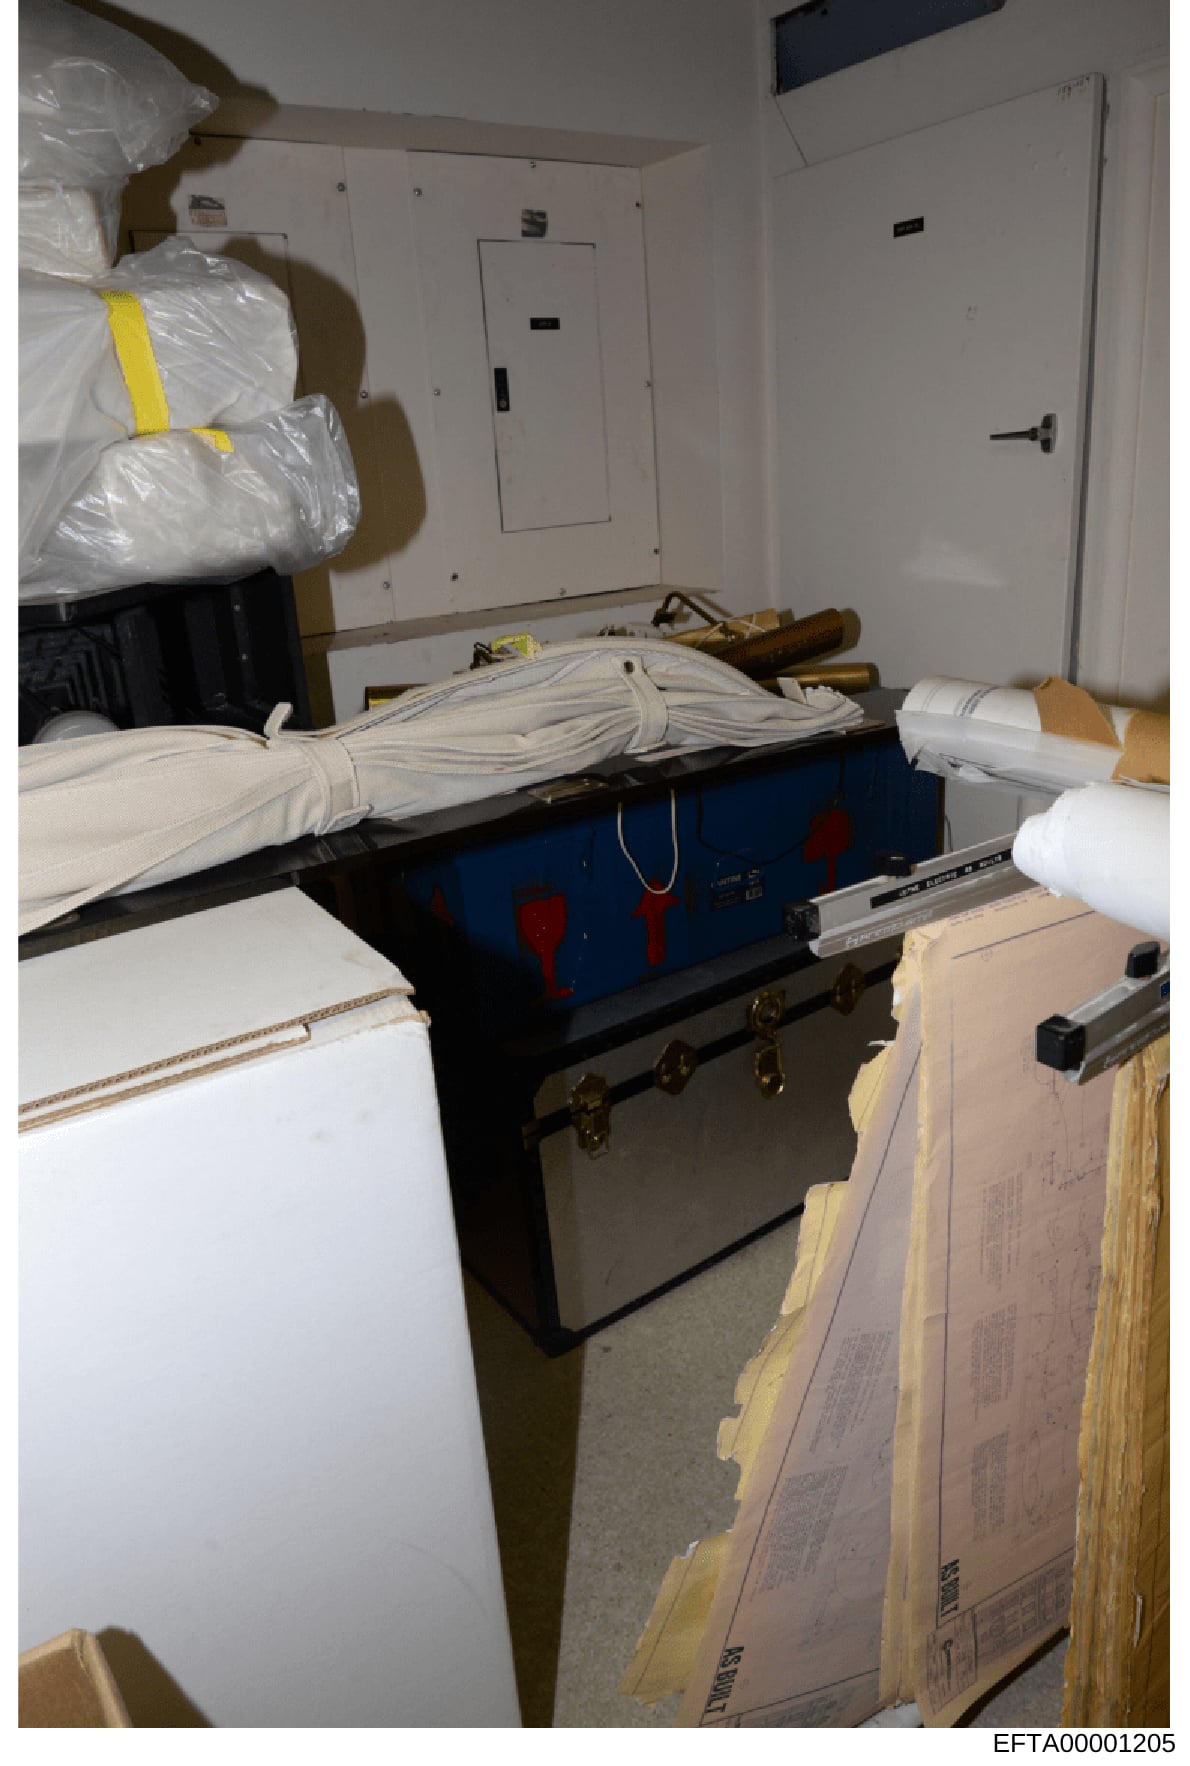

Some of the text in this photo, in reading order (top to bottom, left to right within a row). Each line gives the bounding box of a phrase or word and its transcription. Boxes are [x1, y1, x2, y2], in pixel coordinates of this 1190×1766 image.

[940, 1558, 960, 1618] AS BUILT
[704, 1646, 744, 1713] AS BUILT
